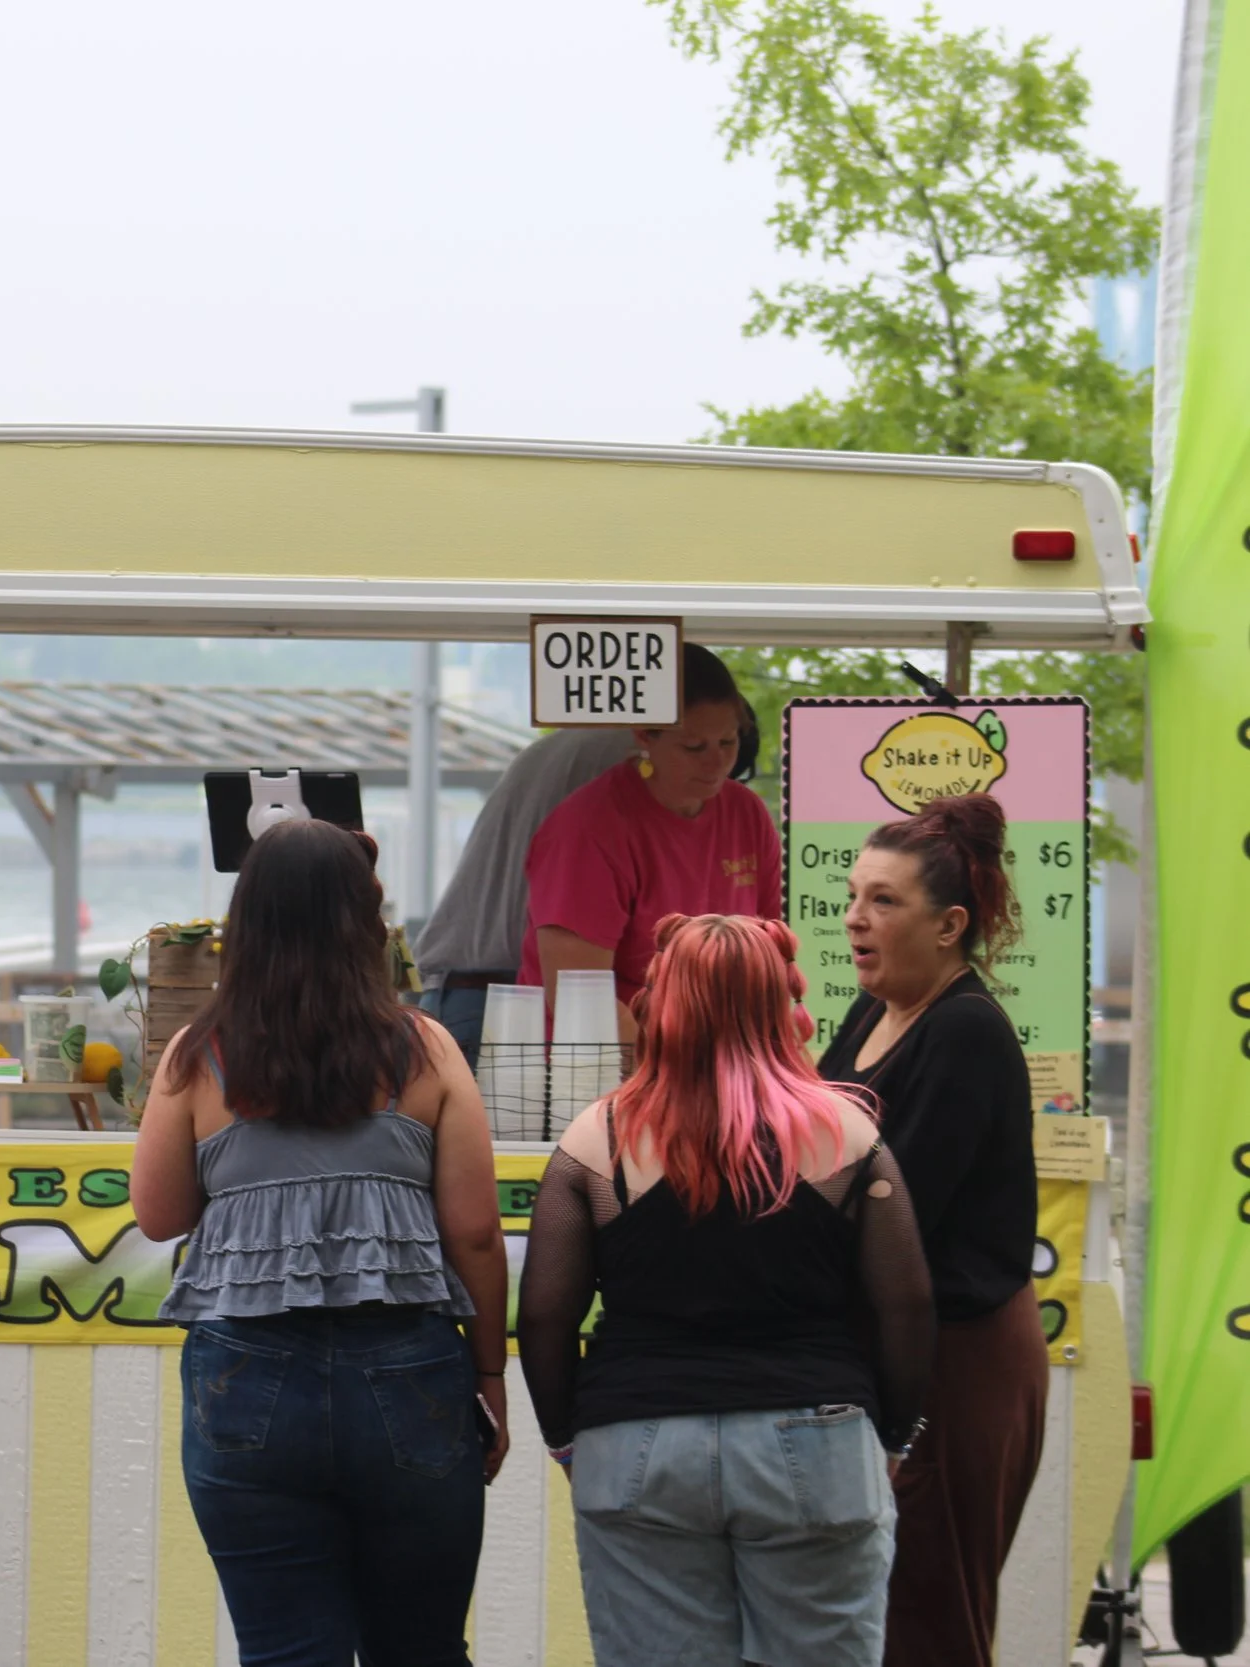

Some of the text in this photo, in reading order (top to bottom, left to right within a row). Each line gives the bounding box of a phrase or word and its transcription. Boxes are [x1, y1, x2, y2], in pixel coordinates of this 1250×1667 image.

[544, 631, 663, 670] ORDER
[564, 674, 646, 713] HERE
[883, 747, 993, 770] Shake it Up
[897, 777, 971, 801] LEMONADE
[1039, 841, 1073, 868] $6
[800, 894, 849, 920] Flav
[1044, 893, 1073, 920] $7
[820, 950, 853, 967] Stra
